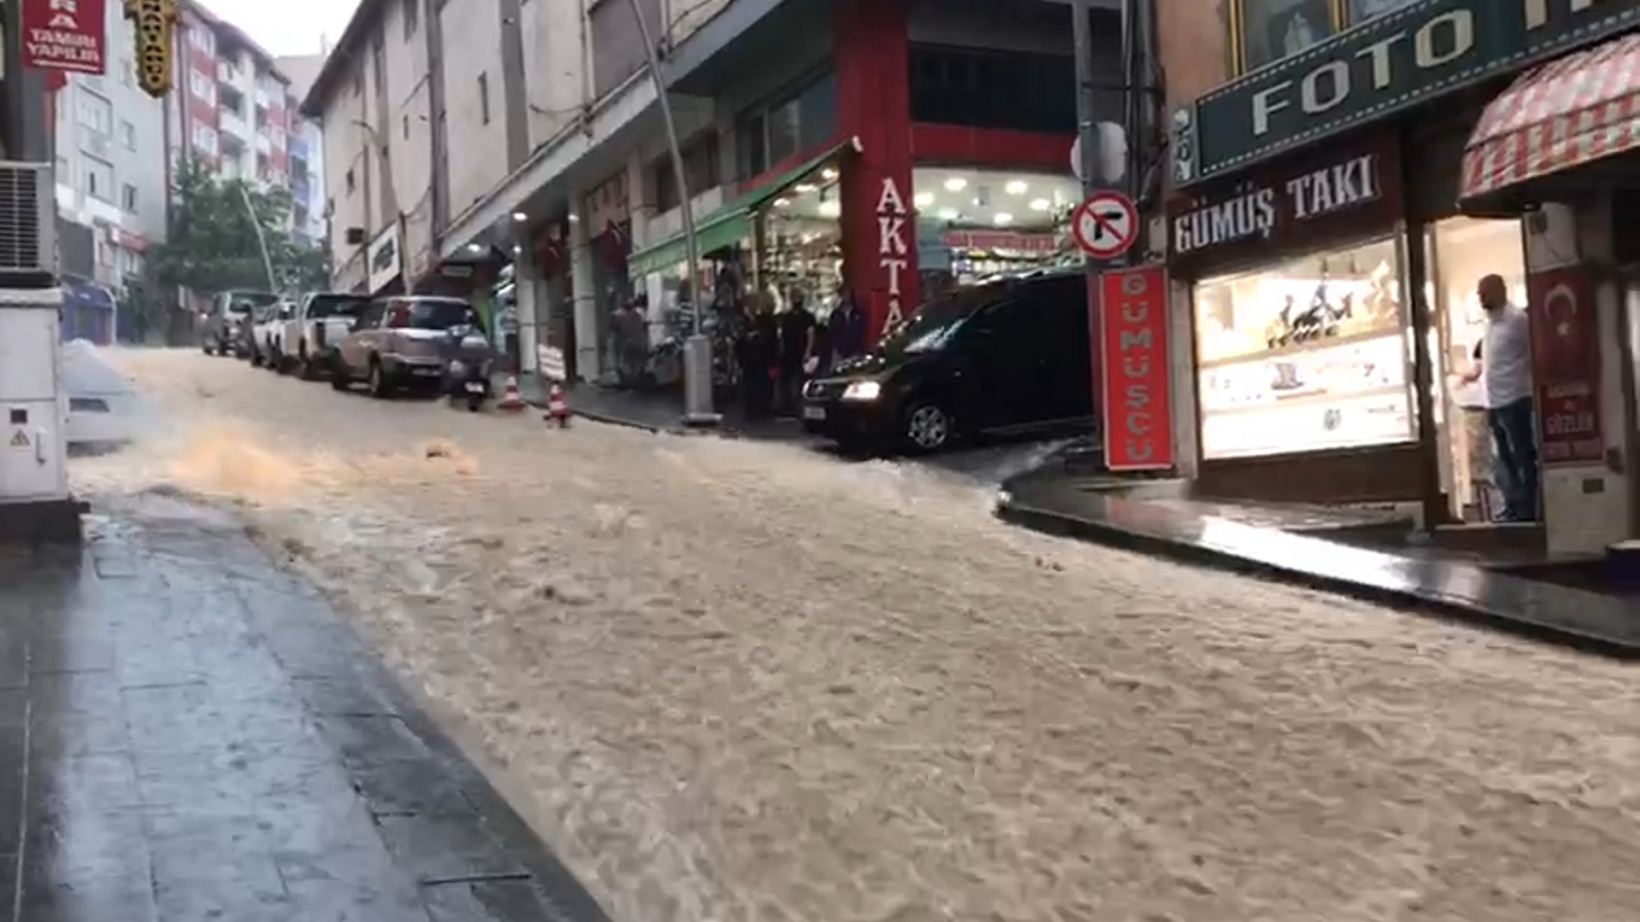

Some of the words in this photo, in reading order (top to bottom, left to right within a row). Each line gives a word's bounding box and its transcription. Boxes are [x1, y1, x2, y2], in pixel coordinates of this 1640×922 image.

[1252, 9, 1475, 136] FOTO
[1175, 181, 1275, 255] GÜMÜŞ
[1286, 155, 1374, 219] TAKI
